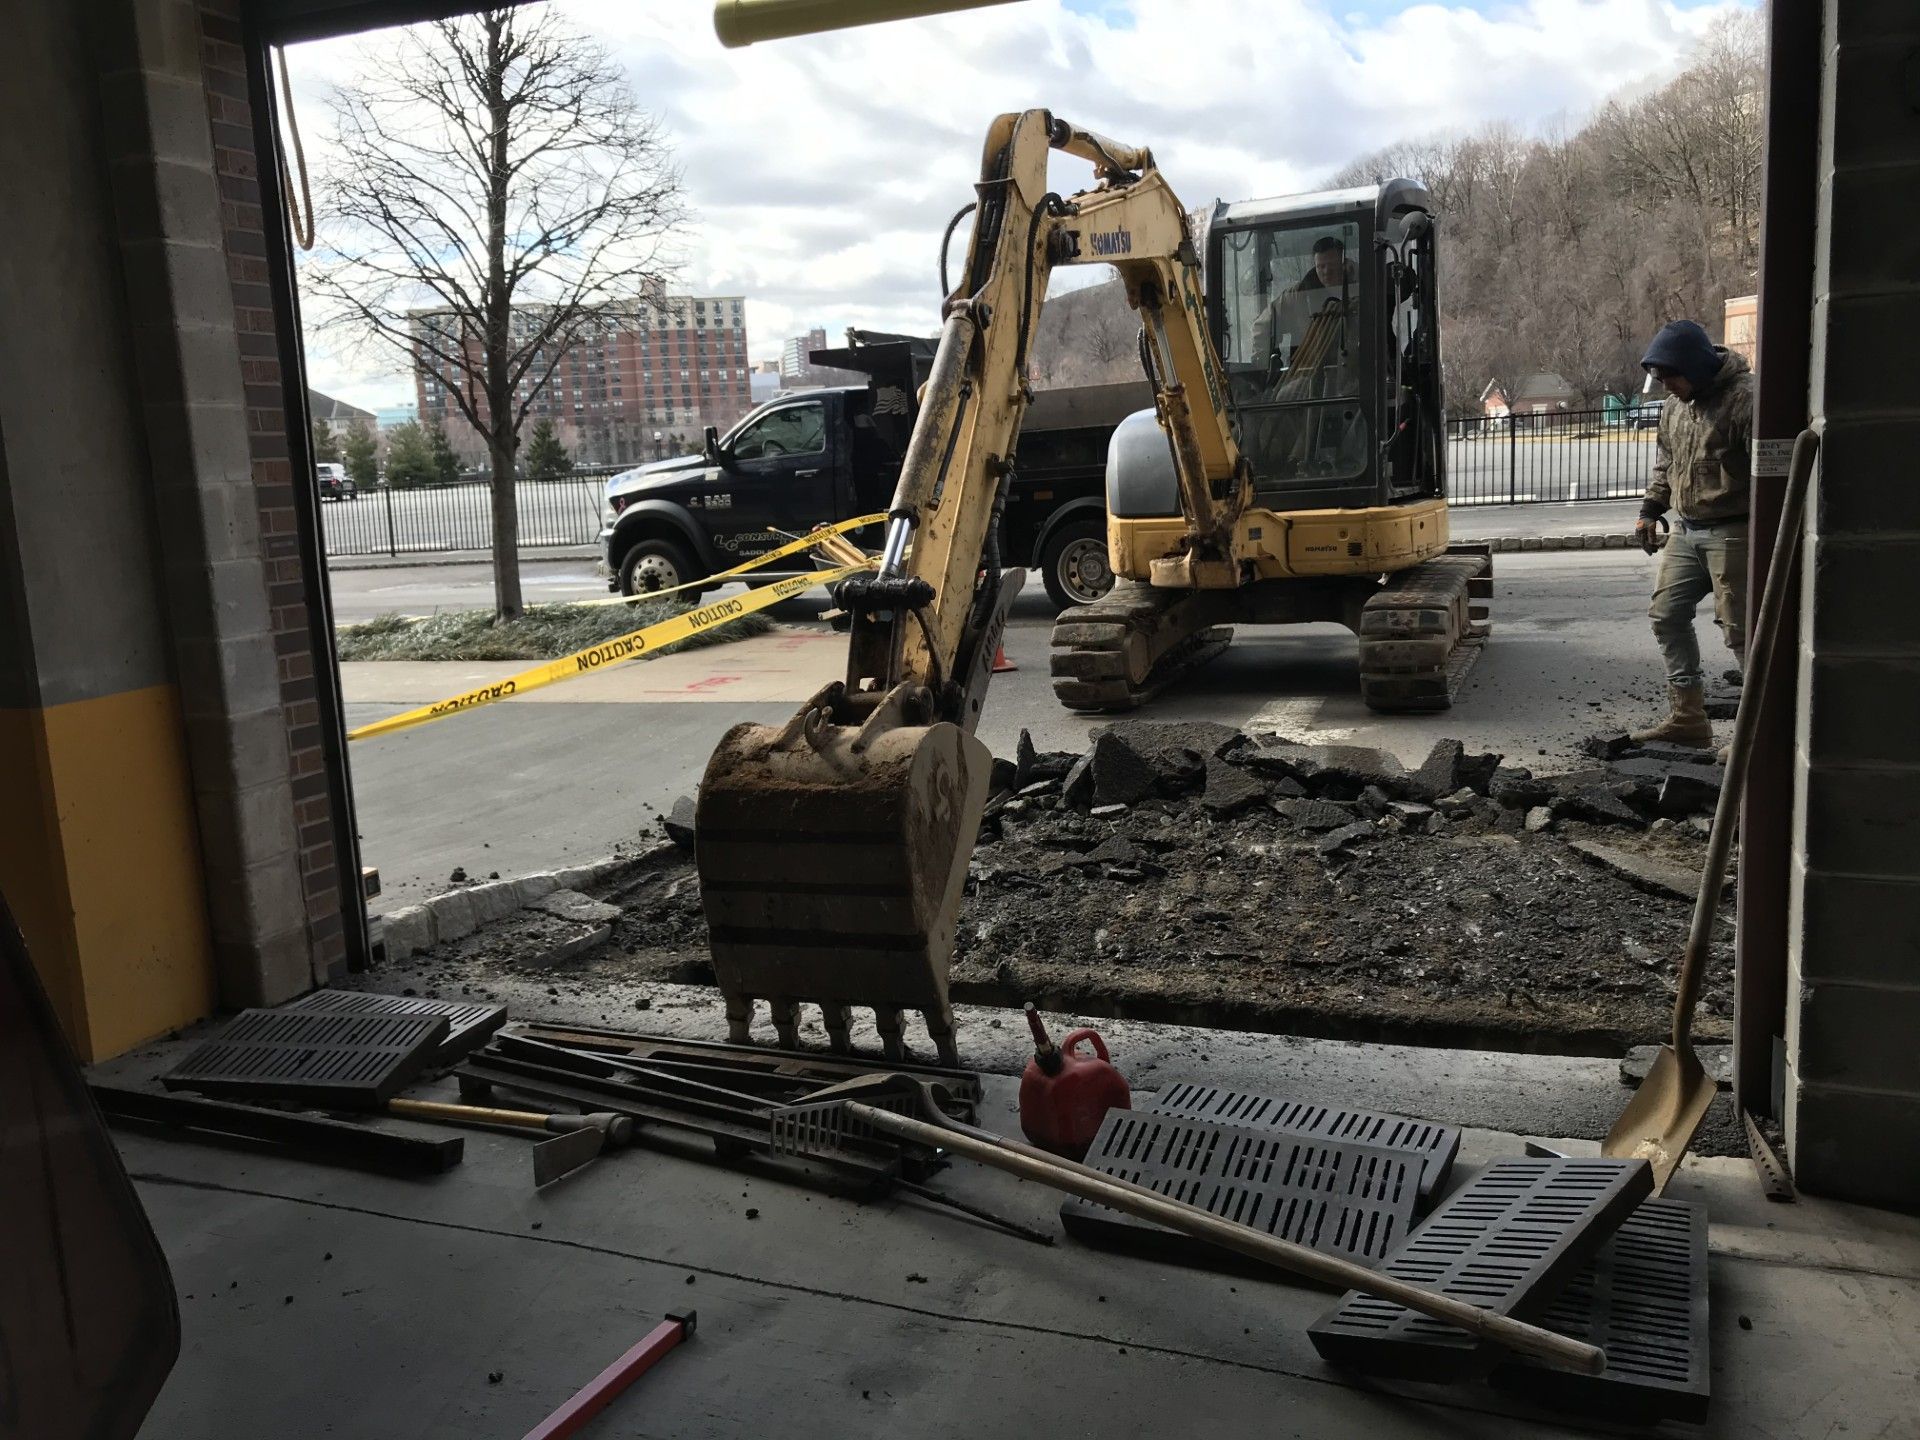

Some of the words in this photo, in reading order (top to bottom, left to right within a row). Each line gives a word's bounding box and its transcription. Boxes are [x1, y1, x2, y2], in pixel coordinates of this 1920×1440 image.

[805, 527, 838, 544] CAUTION
[1304, 545, 1338, 553] KOMATSU
[688, 599, 743, 629] CAUTION
[576, 634, 645, 671] CAUTION
